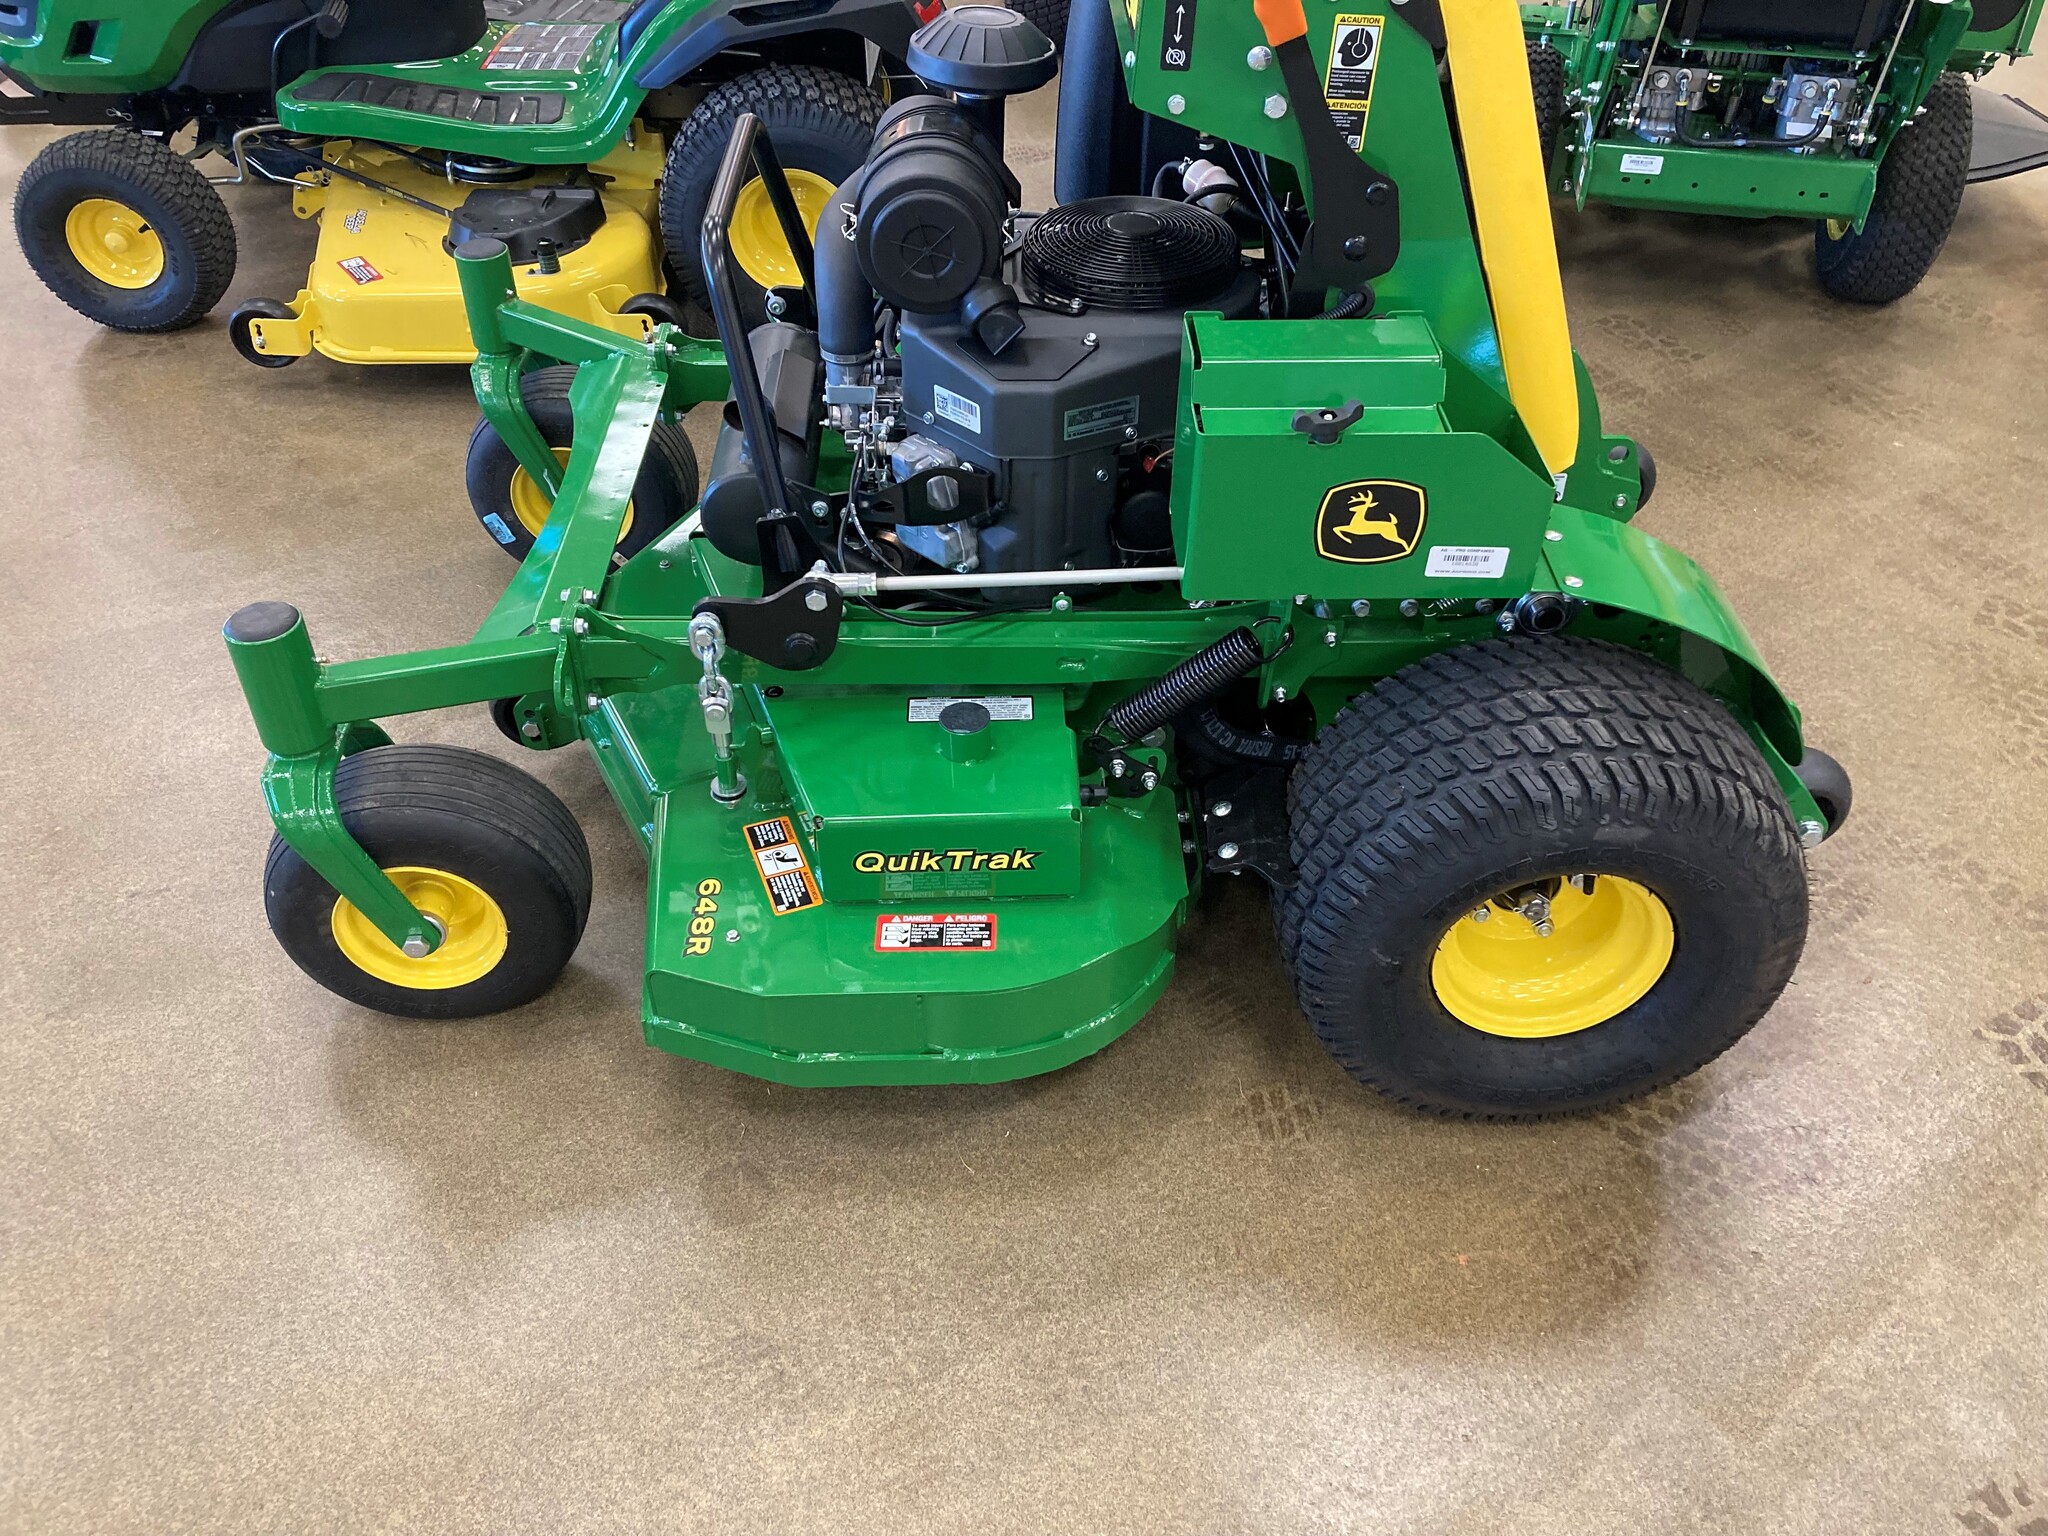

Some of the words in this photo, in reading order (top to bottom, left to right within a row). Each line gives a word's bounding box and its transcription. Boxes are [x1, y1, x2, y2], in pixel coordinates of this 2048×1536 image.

[1346, 16, 1381, 25] CAUTION
[1331, 101, 1367, 109] ATENCIÓN
[853, 848, 1045, 873] QuikTrak
[682, 877, 723, 957] 648R
